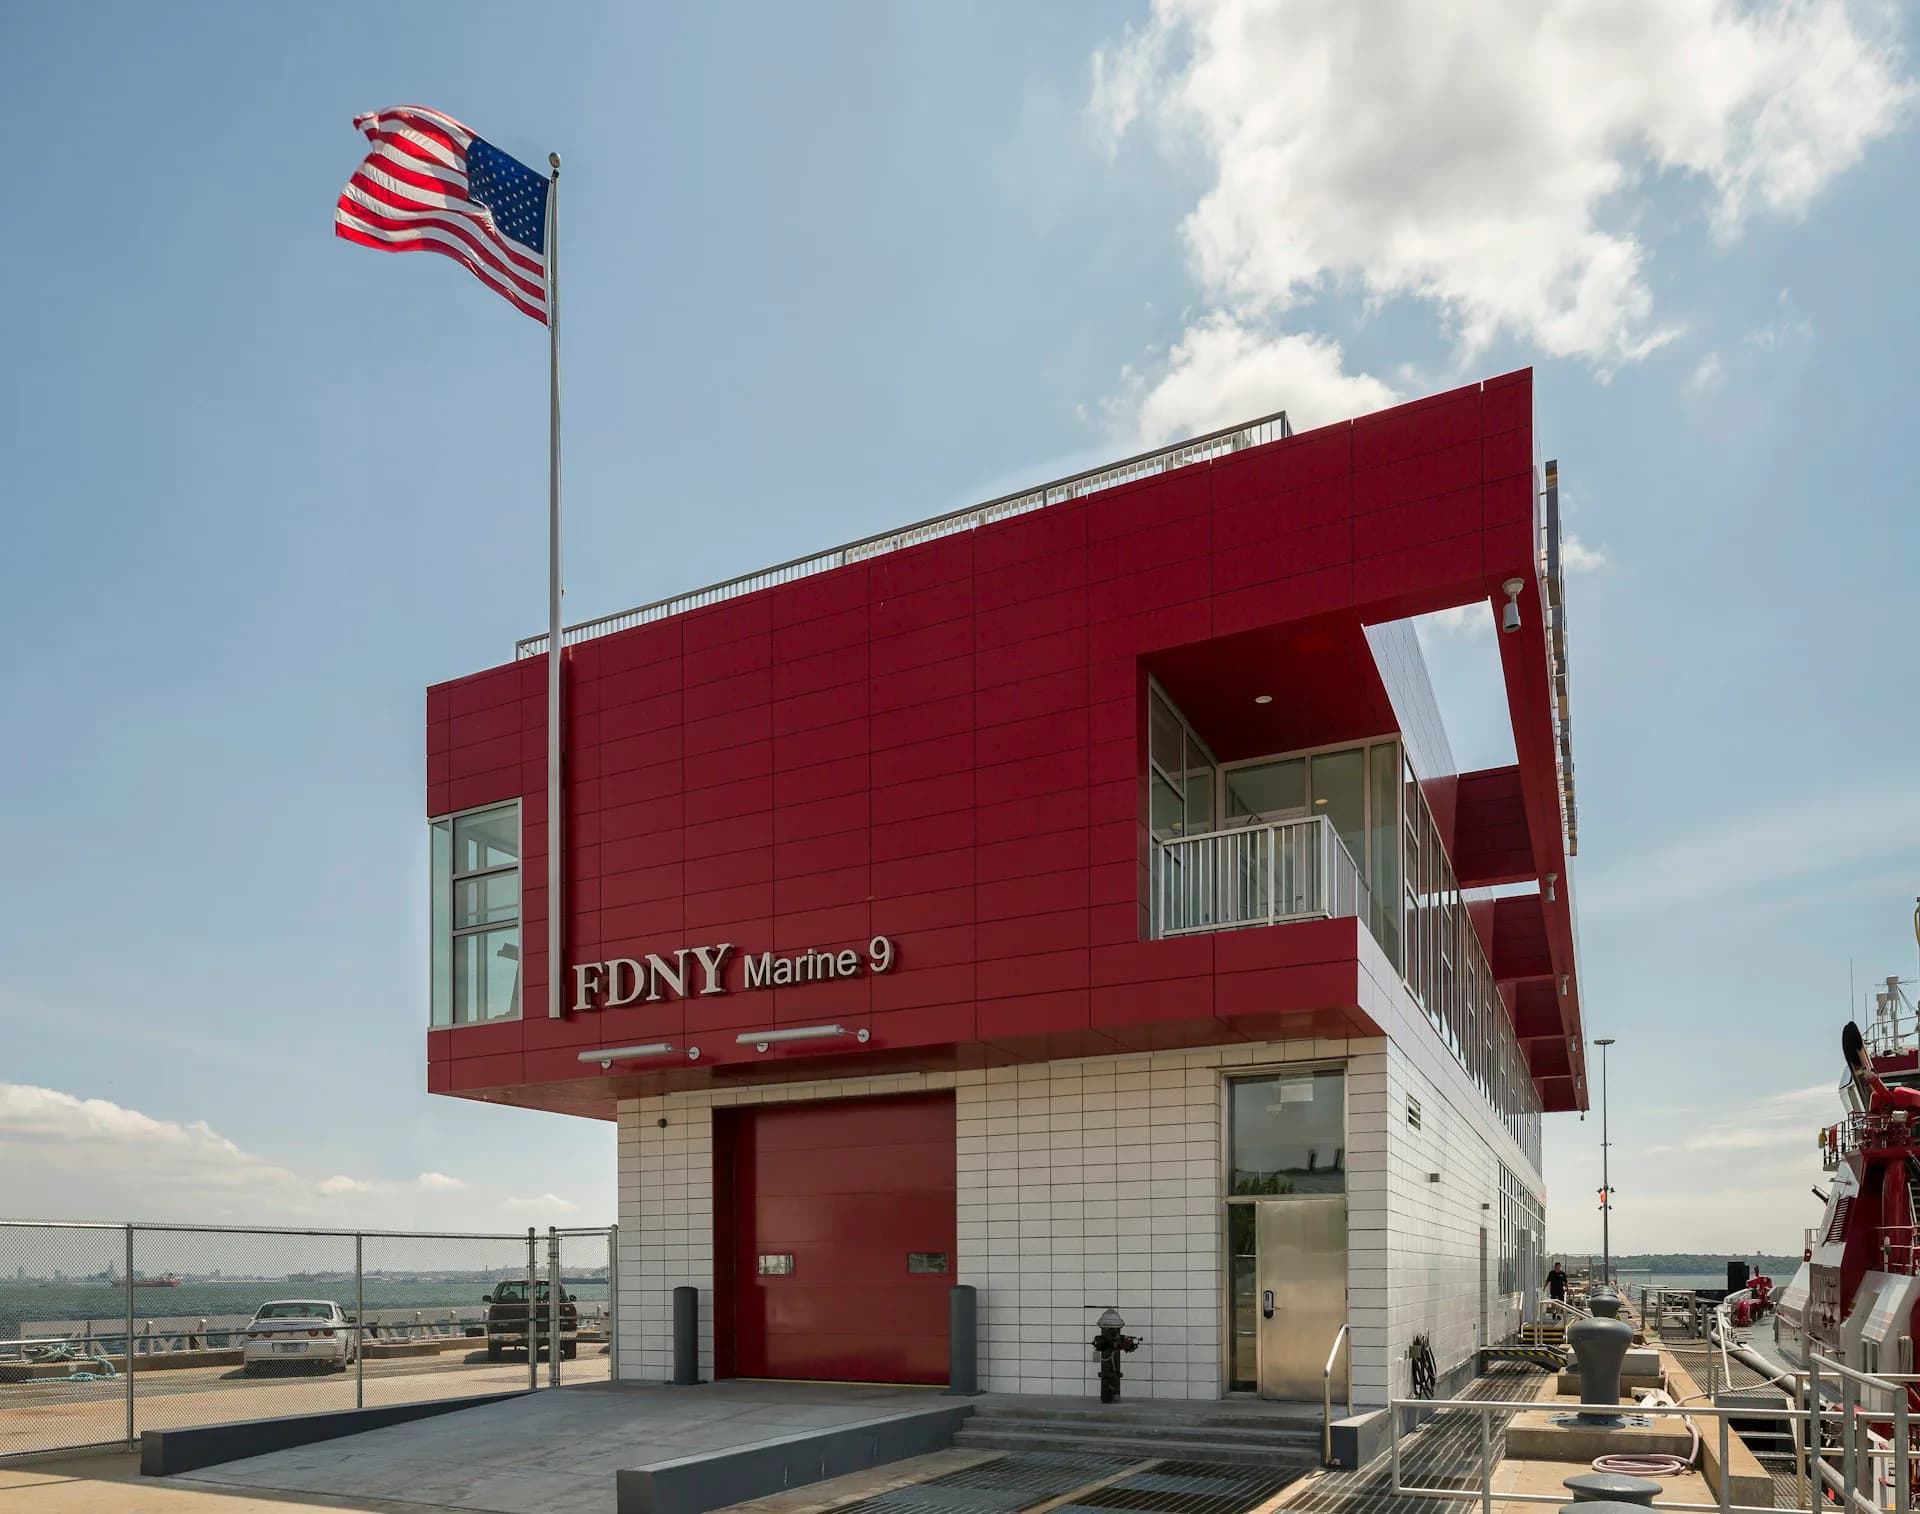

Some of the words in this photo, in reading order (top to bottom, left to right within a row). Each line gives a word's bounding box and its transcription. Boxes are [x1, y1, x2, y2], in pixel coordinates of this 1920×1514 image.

[572, 943, 734, 1011] FDNY
[743, 948, 858, 989] Marine
[869, 935, 894, 973] 9
